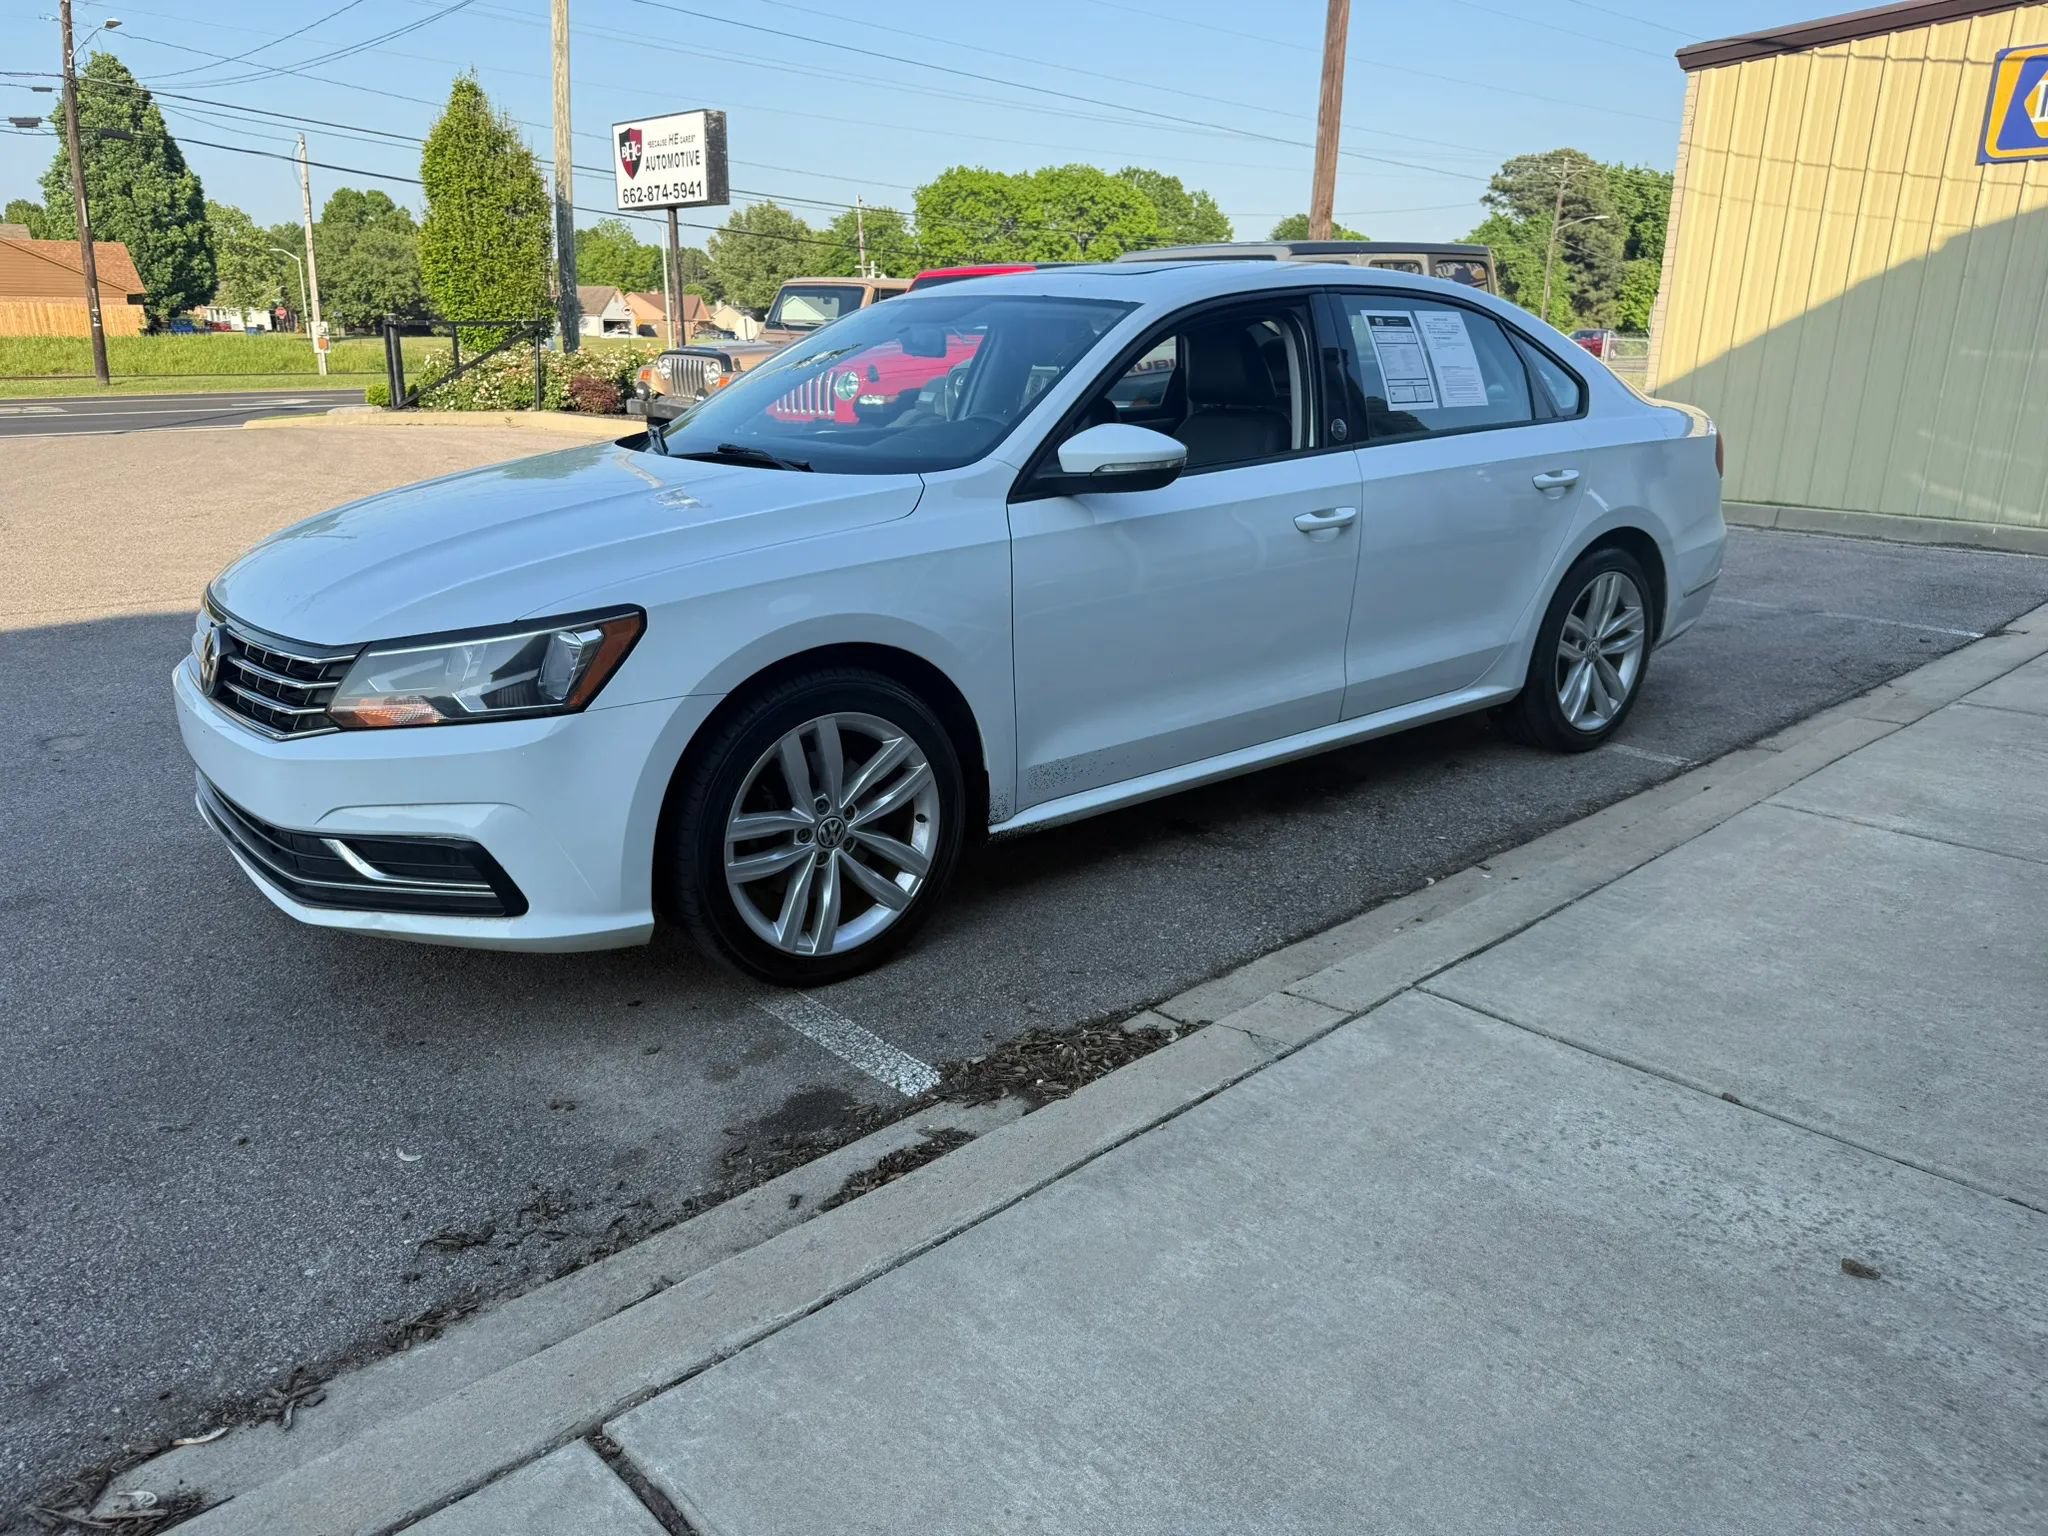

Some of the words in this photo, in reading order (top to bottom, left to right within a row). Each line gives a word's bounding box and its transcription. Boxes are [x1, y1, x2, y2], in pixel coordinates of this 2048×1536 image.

[668, 133, 679, 146] HE
[645, 150, 701, 172] AUTOMOTIVE
[623, 180, 702, 204] 662-874-5941
